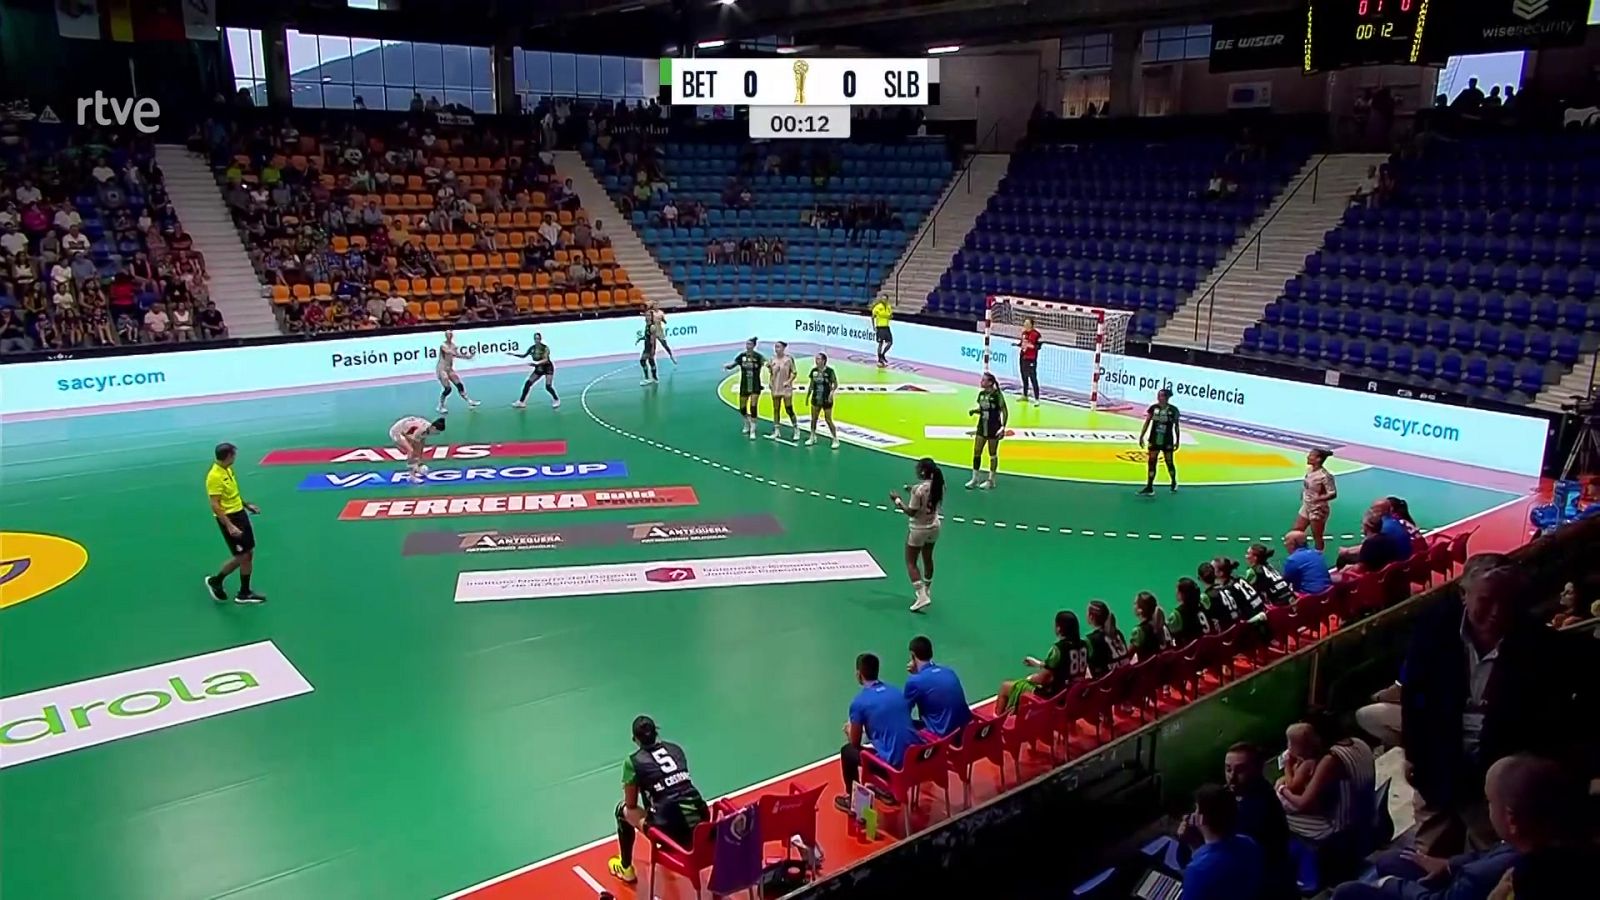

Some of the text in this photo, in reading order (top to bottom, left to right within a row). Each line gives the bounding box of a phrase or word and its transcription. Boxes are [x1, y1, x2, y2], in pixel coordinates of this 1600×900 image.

[1215, 33, 1285, 51] BE WISER
[1356, 22, 1394, 40] 00:12
[795, 319, 876, 341] Pasión por la excelen
[332, 340, 519, 368] Pasión por la celencia
[57, 369, 166, 392] sacyr.com
[1099, 366, 1245, 405] Pasión por la excelencia
[1023, 430, 1137, 440] Iberdrol
[1373, 414, 1459, 441] sacyr.com
[330, 444, 493, 463] AVIS
[360, 493, 588, 518] FERREIRA
[1069, 646, 1088, 675] 88
[651, 747, 678, 774] 5
